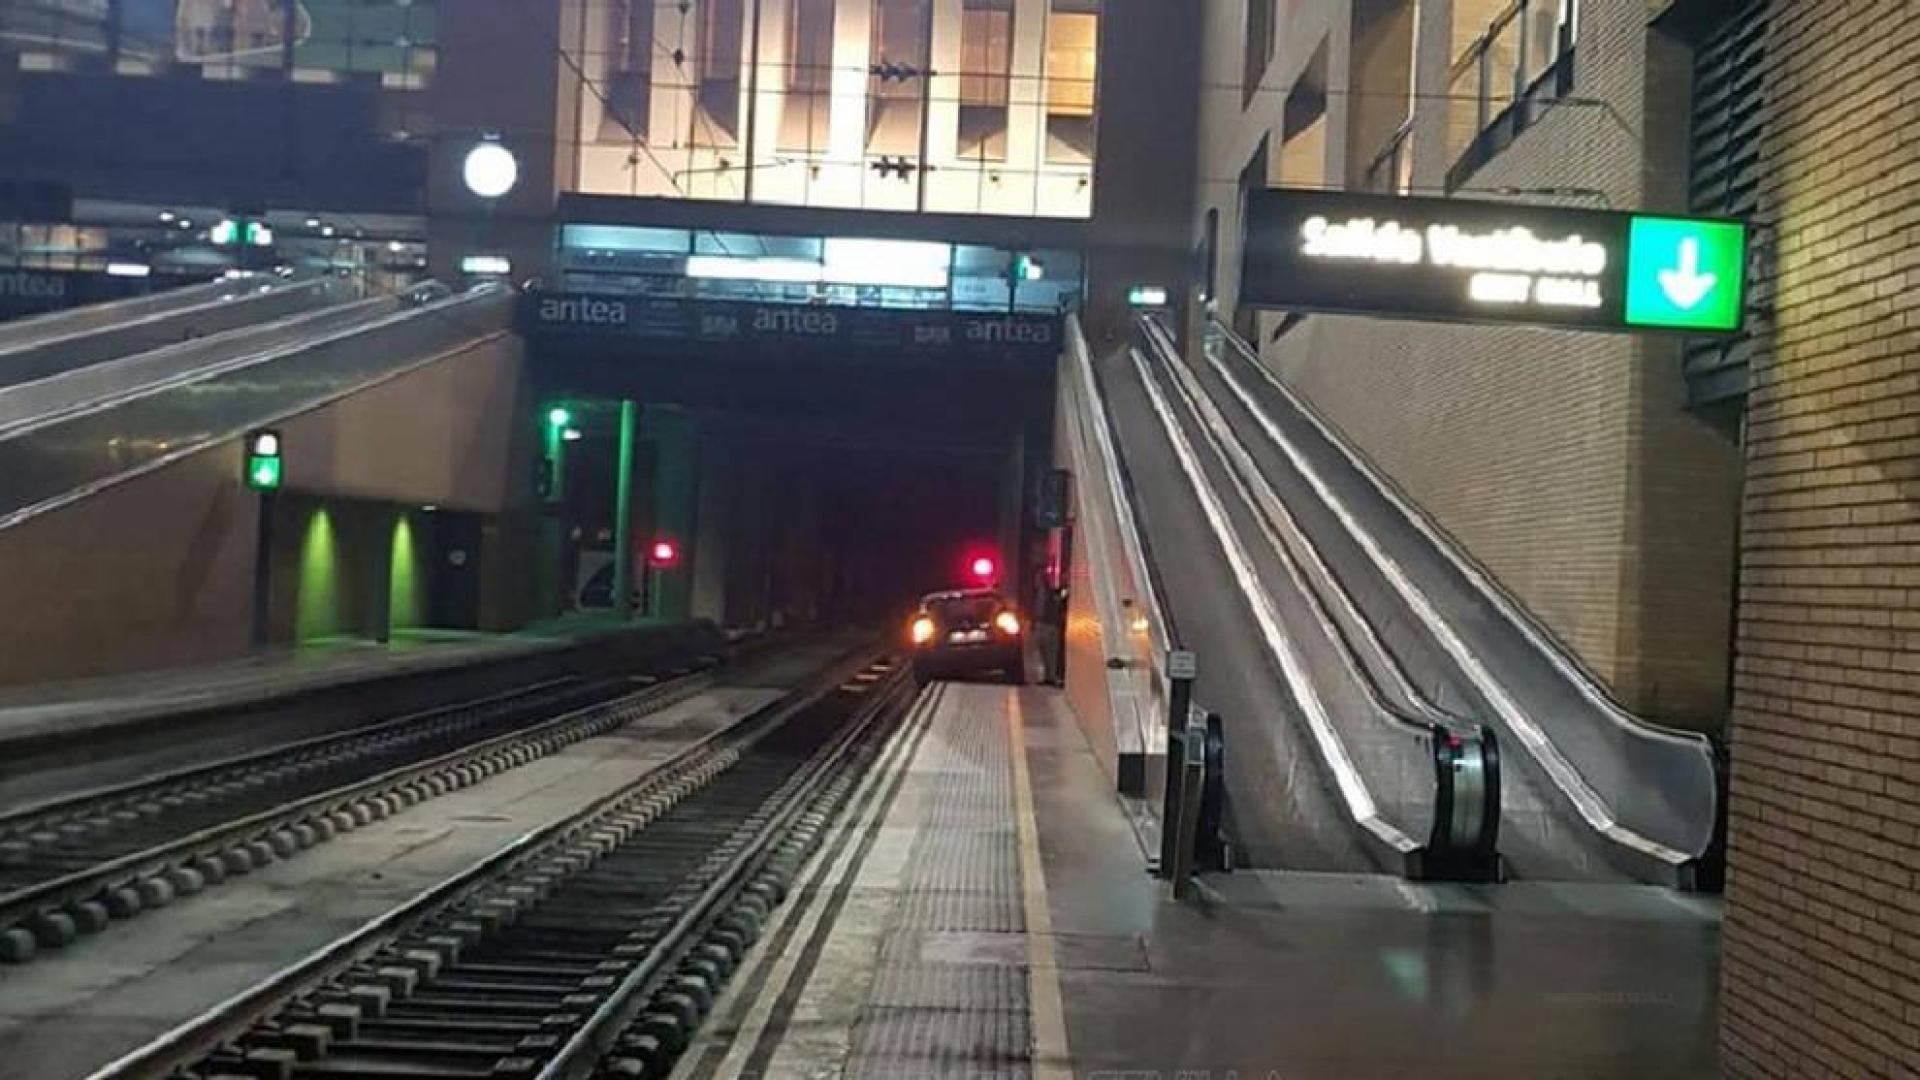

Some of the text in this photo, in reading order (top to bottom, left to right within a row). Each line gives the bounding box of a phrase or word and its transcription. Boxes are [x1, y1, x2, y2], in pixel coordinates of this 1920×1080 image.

[540, 297, 626, 324] antea
[753, 305, 838, 334] antea
[966, 317, 1050, 344] antea
